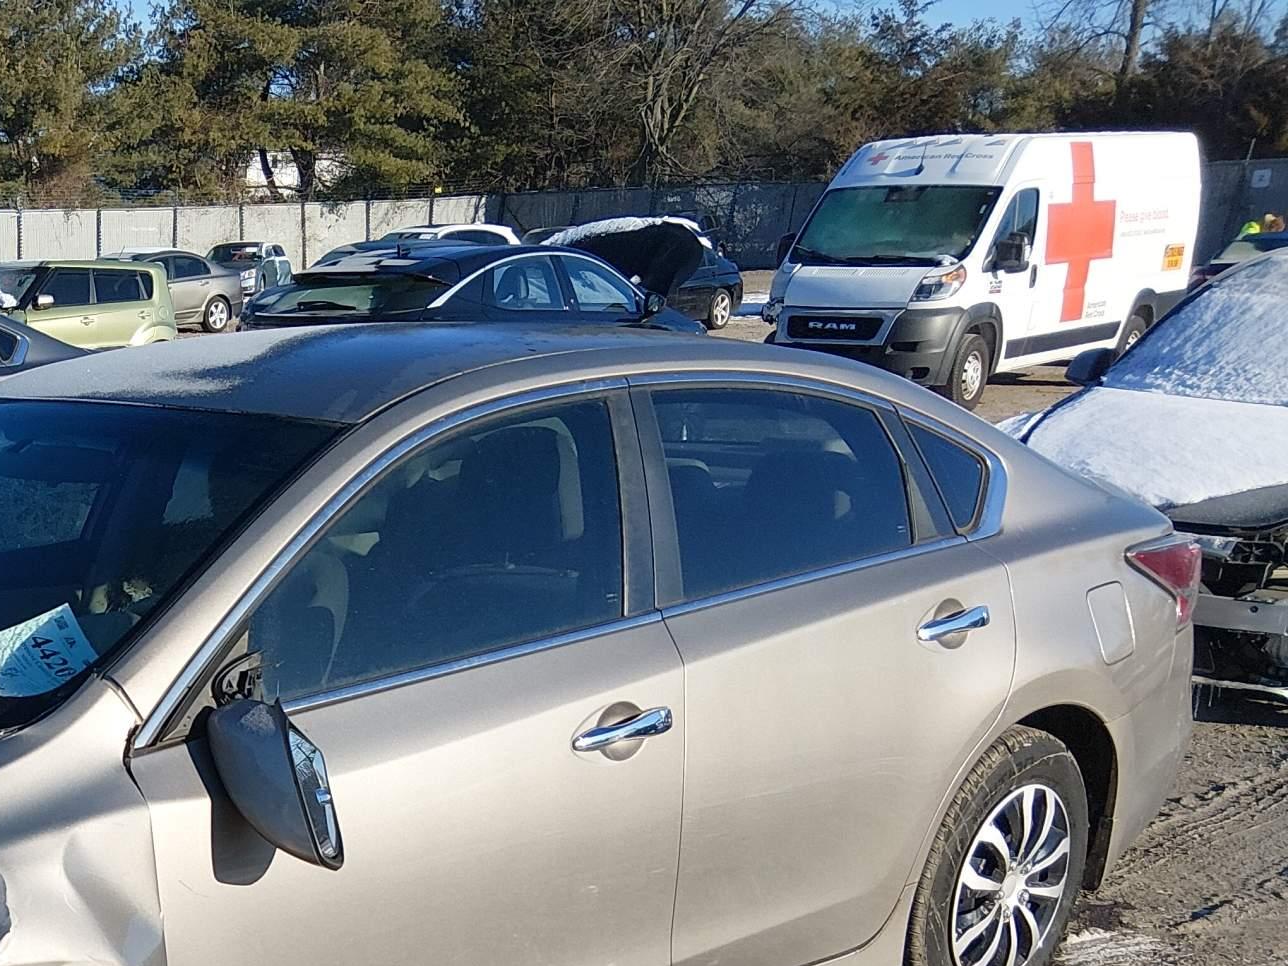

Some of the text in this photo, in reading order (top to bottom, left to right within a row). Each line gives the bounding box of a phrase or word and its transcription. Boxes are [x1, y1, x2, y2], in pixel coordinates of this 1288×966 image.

[894, 153, 942, 161] Amercan
[964, 152, 994, 160] Cross
[808, 321, 856, 330] RAM
